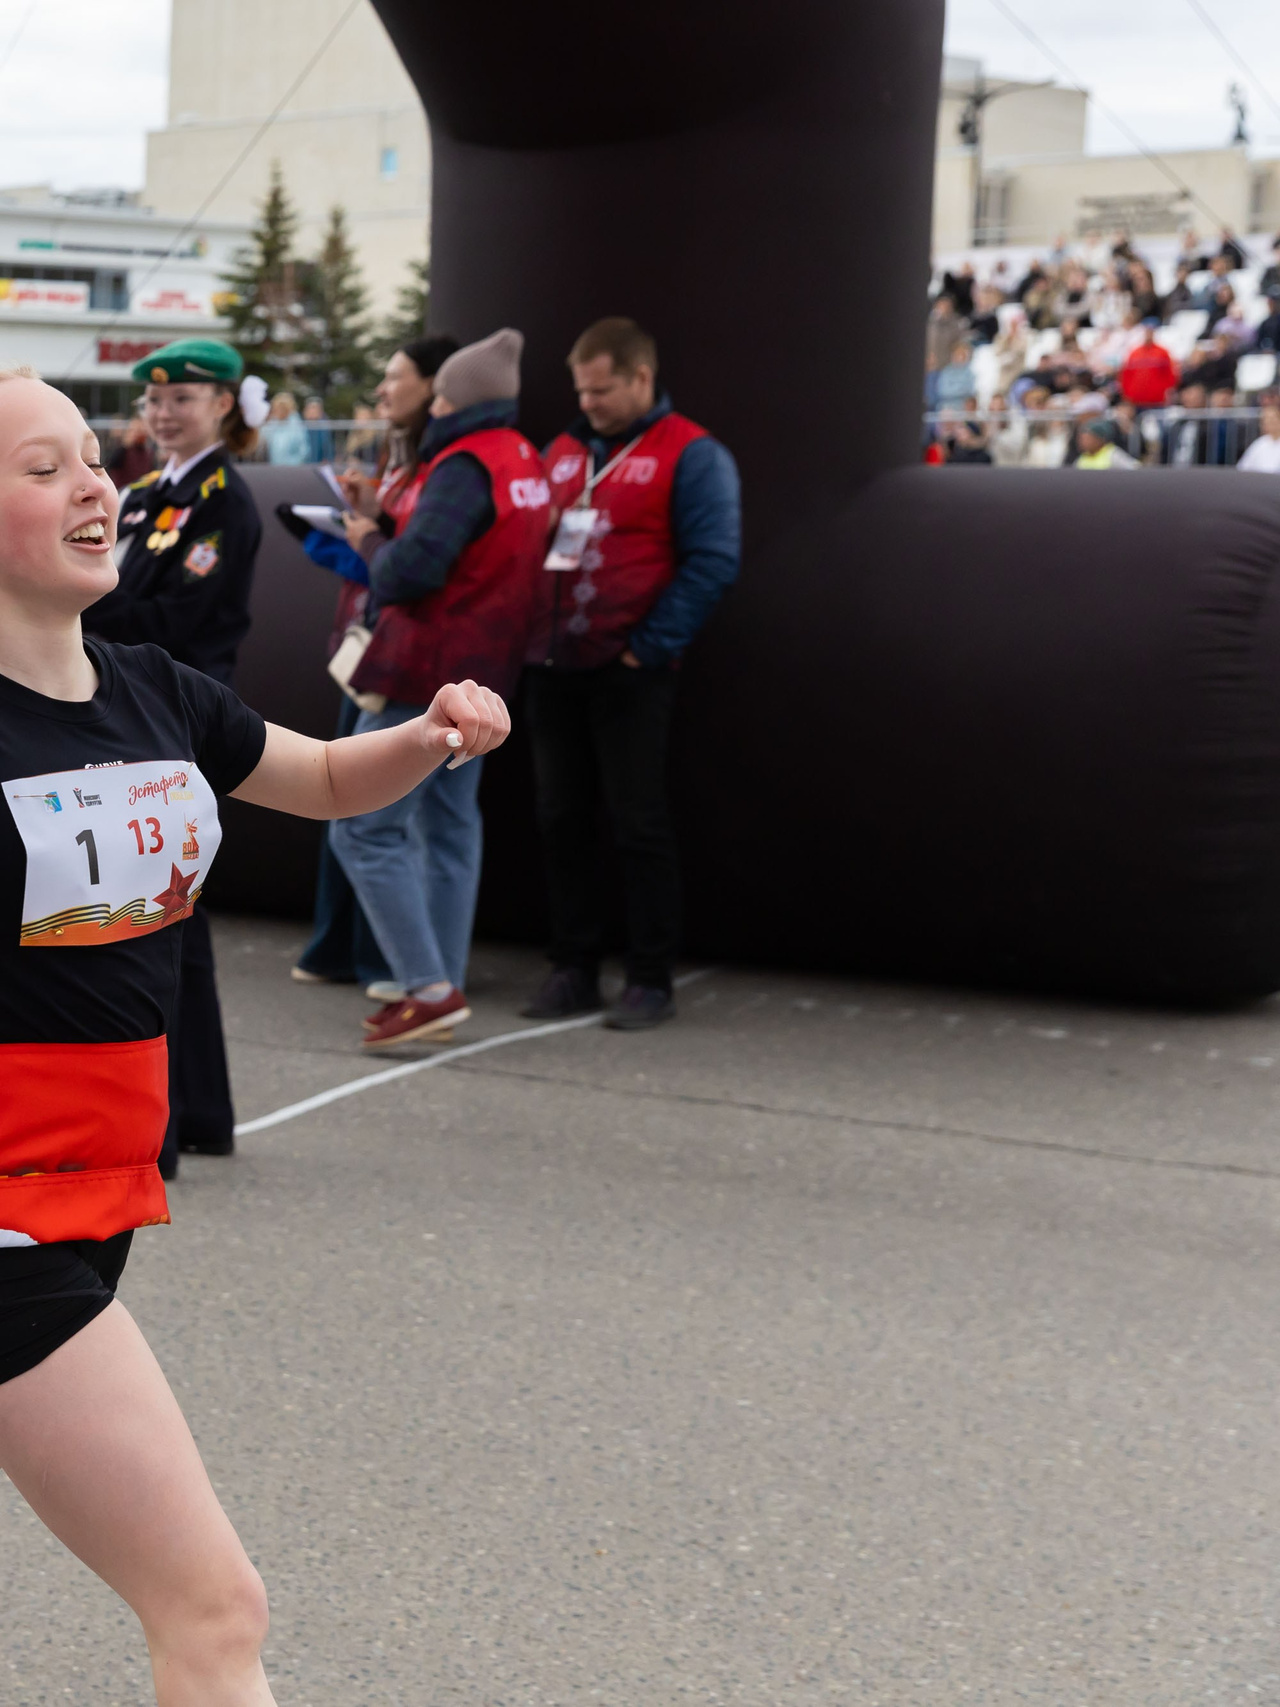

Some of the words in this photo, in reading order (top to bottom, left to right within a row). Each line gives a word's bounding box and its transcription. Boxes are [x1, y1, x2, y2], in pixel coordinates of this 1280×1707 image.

[128, 770, 190, 806] Эстафета
[127, 816, 165, 856] 13
[75, 829, 100, 886] 1
